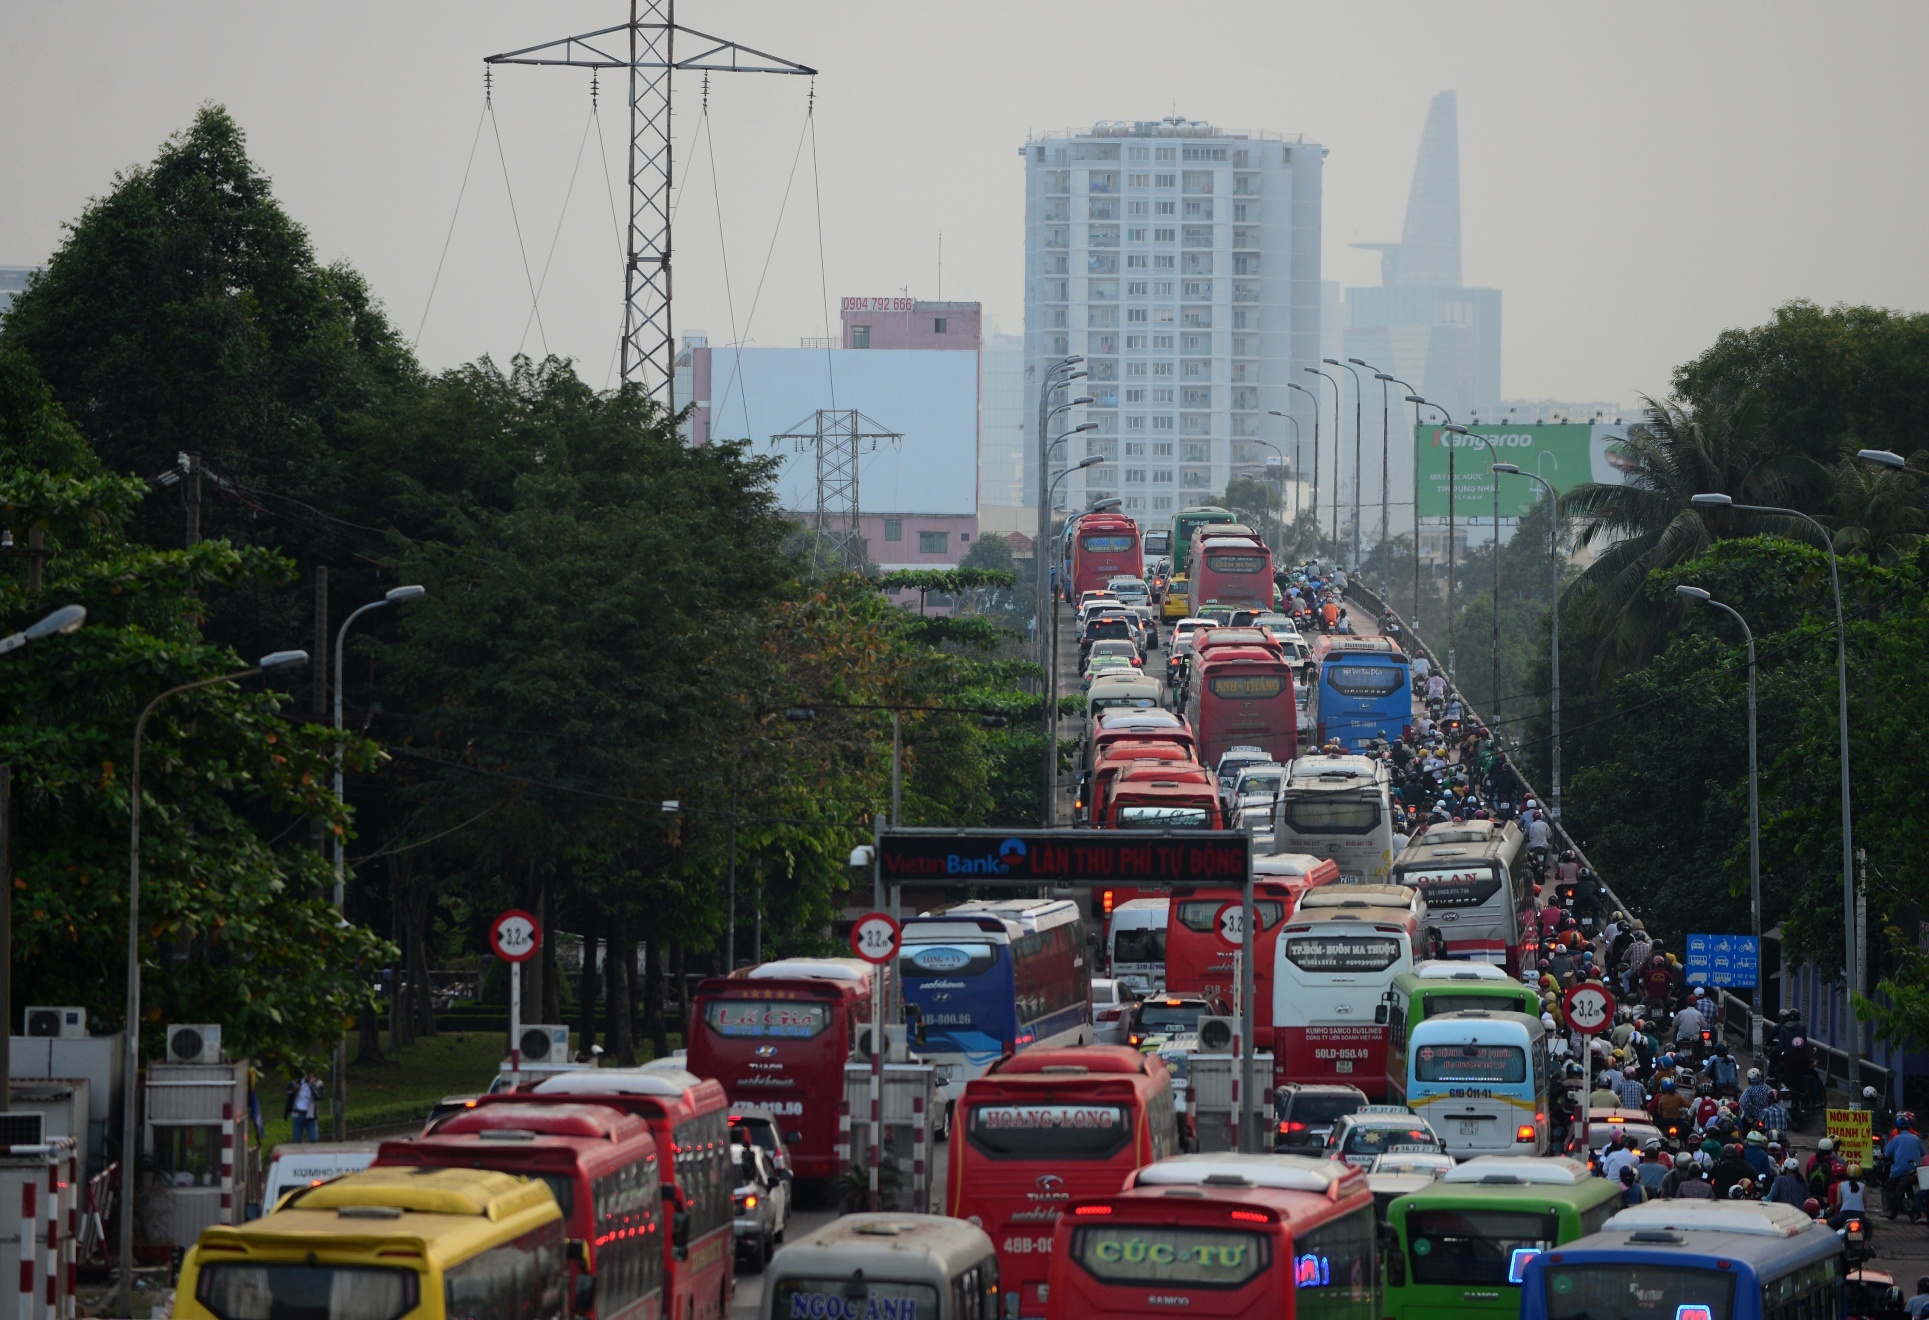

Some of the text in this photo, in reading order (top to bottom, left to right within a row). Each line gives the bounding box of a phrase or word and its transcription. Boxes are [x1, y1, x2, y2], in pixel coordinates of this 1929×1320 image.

[843, 297, 912, 311] 0904 792 666
[1216, 681, 1237, 692] ANH
[885, 842, 1243, 880] VietinBank LÀN THU PHÍ TỰ ĐỘNG
[1436, 873, 1478, 887] LAN
[1326, 943, 1352, 955] BUÔN
[1352, 945, 1366, 955] MA
[1367, 943, 1397, 957] THUỘT
[764, 1008, 815, 1026] Gia
[1329, 1027, 1352, 1035] SAMCO
[1315, 1049, 1369, 1059] 50LD-050.49
[986, 1104, 1114, 1130] HOÀNG LONG
[1828, 1126, 1871, 1139] THANH LÝ
[293, 1168, 335, 1178] KUMHO
[1096, 1237, 1247, 1268] CÚC TƯ
[1148, 1295, 1190, 1306] SAMCO
